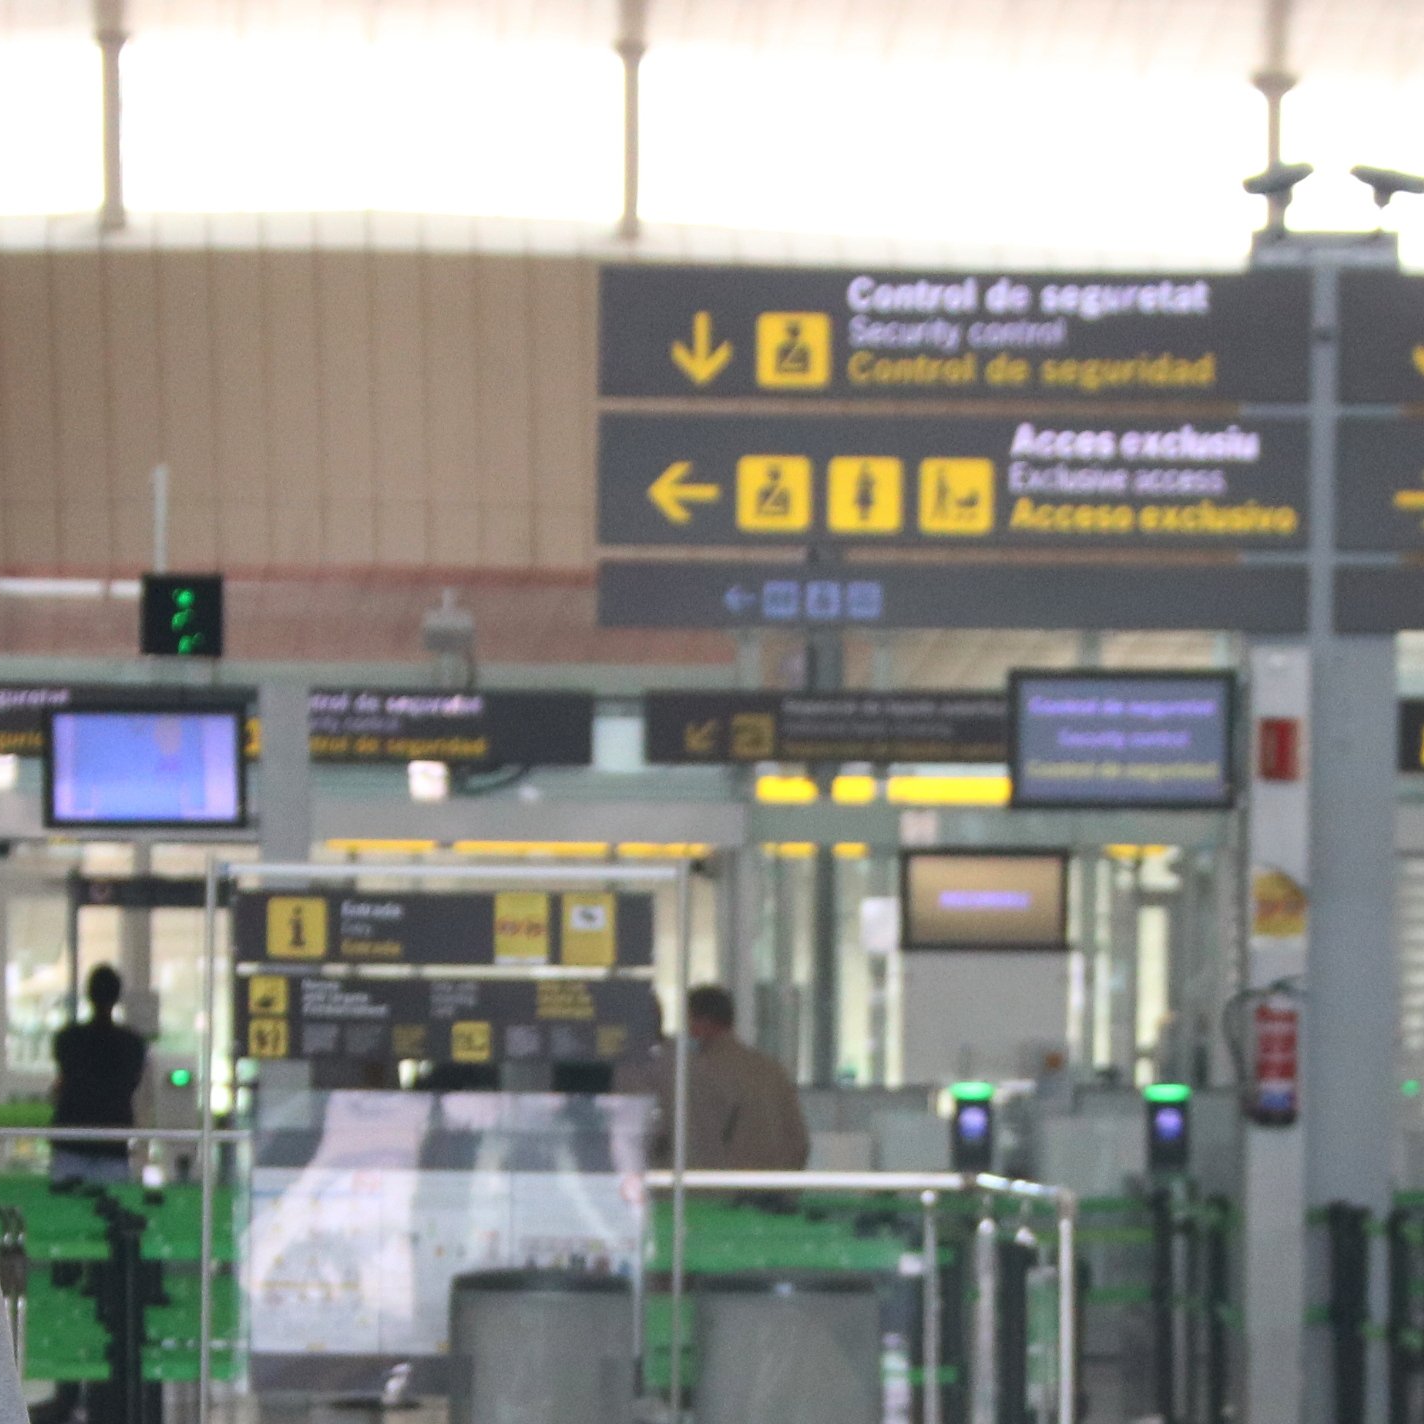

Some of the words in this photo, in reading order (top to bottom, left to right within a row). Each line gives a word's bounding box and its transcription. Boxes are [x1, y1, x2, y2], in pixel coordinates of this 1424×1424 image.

[847, 275, 977, 313] Control
[986, 277, 1033, 313] de
[1040, 280, 1210, 320] seguretat
[848, 316, 960, 352] Security
[968, 317, 1067, 348] control
[847, 351, 976, 386] Control
[986, 353, 1033, 386] de
[1041, 354, 1216, 391] seguridad
[1119, 424, 1261, 463] exclusiu
[1133, 468, 1227, 496] access
[1009, 496, 1135, 533] Acceso
[1138, 499, 1299, 535] exclusivo
[354, 694, 380, 714] de
[354, 734, 380, 755] de
